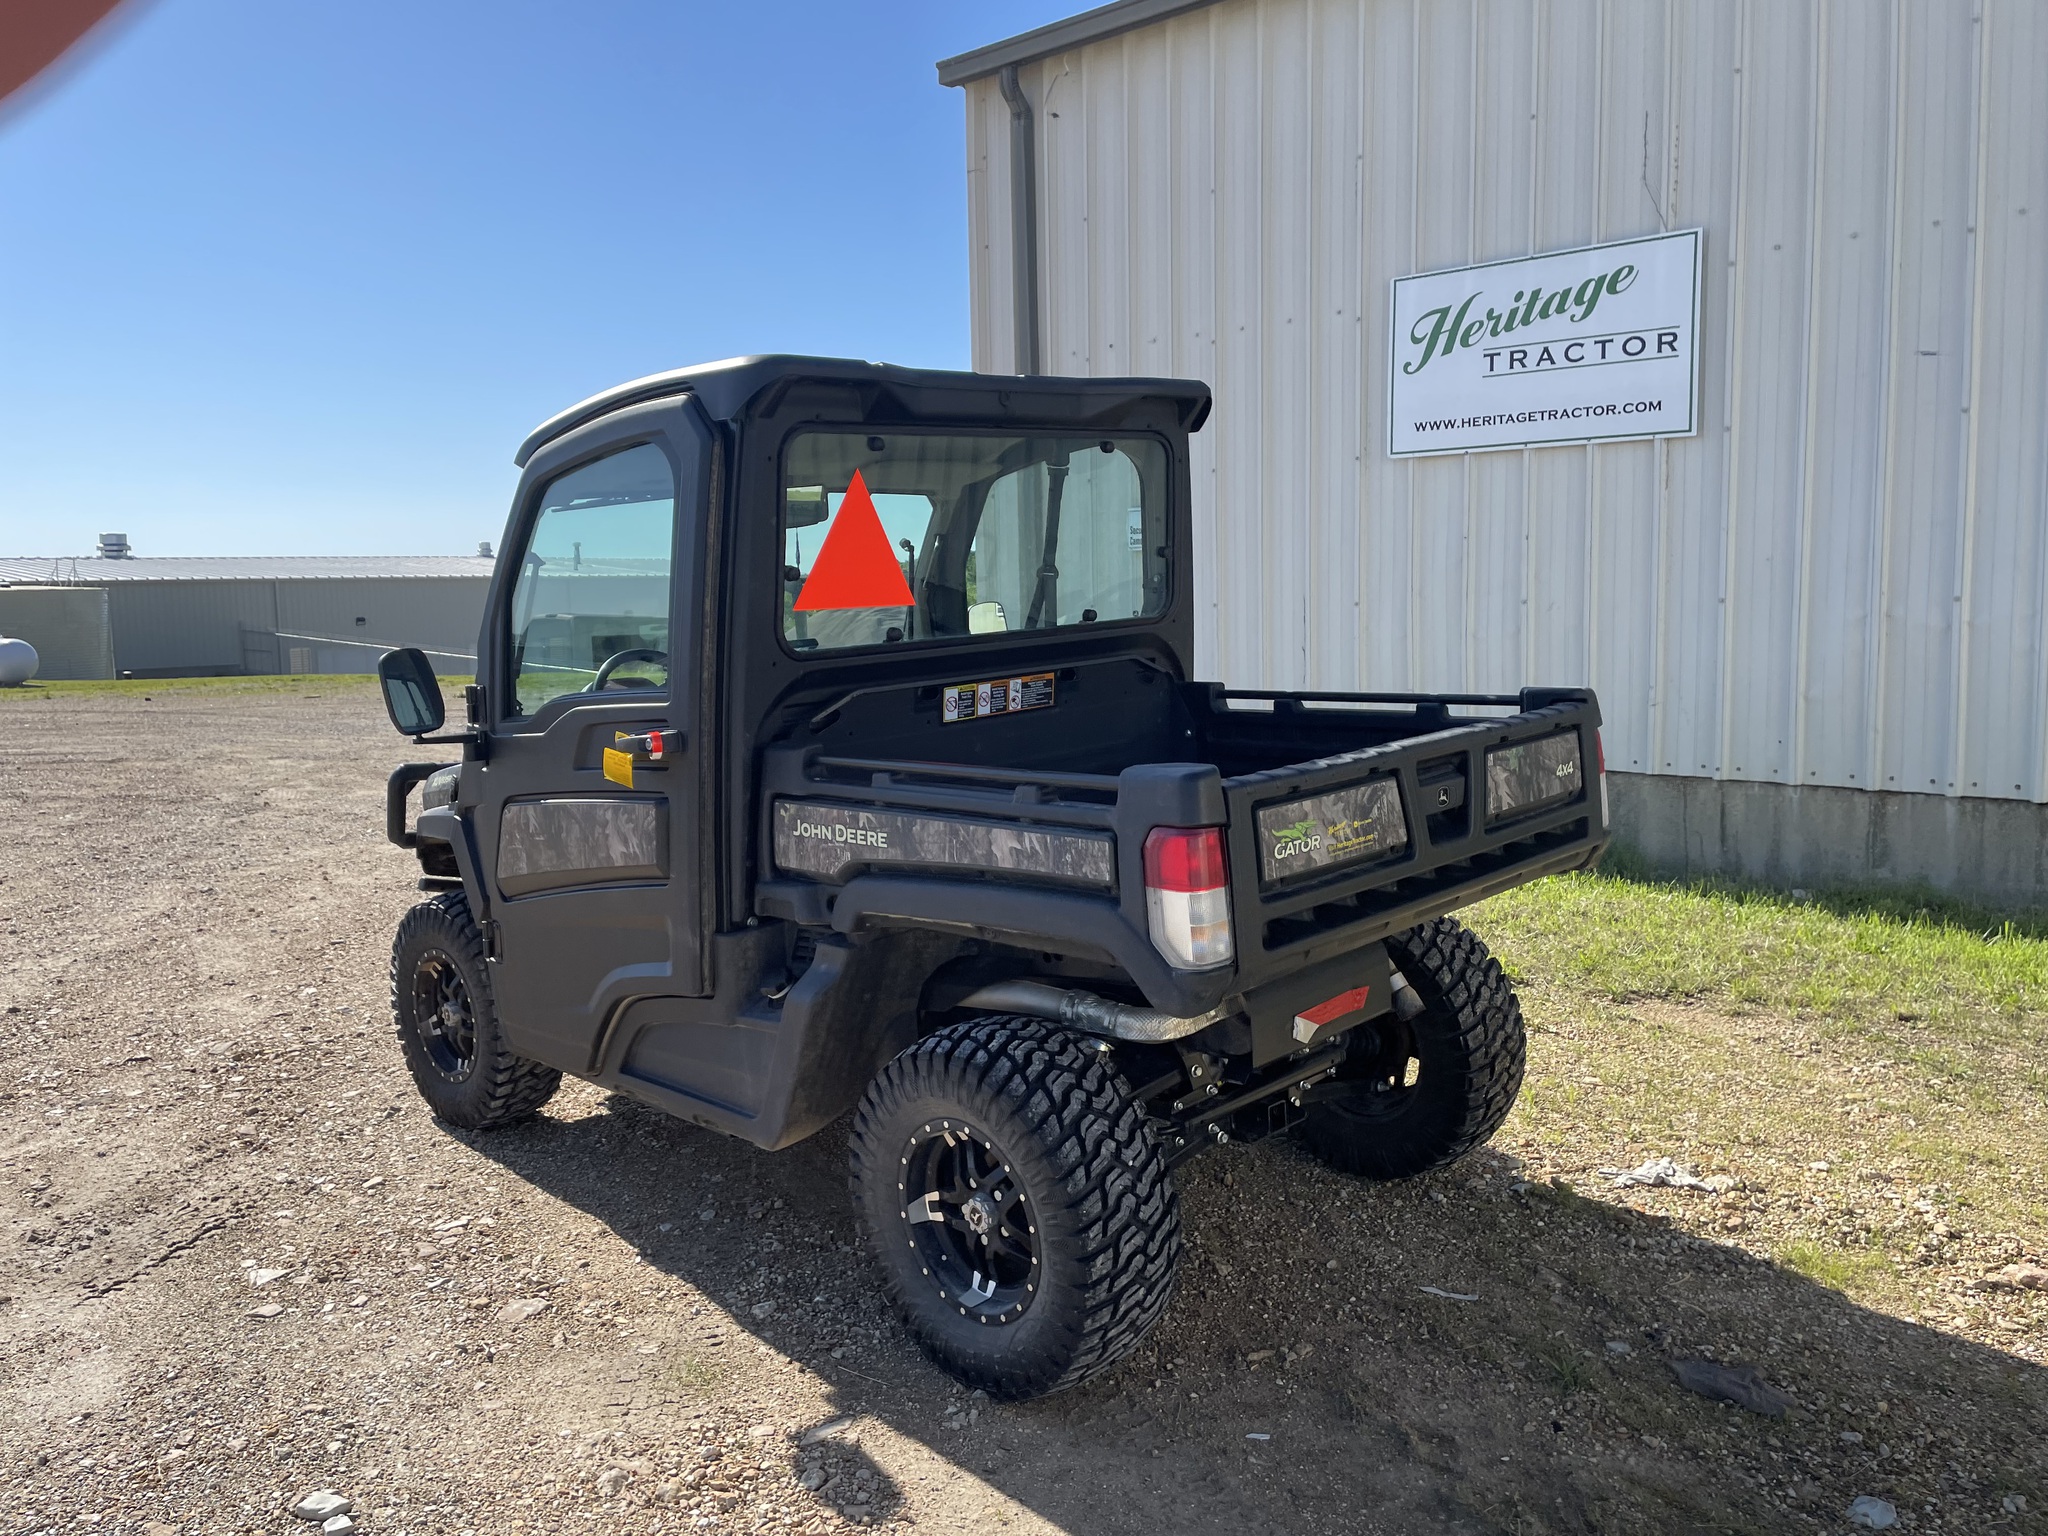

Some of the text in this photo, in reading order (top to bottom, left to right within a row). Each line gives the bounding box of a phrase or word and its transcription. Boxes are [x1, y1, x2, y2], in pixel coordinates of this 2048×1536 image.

[1403, 264, 1640, 375] Heritage
[1483, 331, 1679, 372] TRACTOR
[1414, 400, 1662, 433] WWW.HERITAGETRACTOR.COM
[793, 819, 888, 848] JOHN DEERE
[1274, 835, 1321, 859] GATOR
